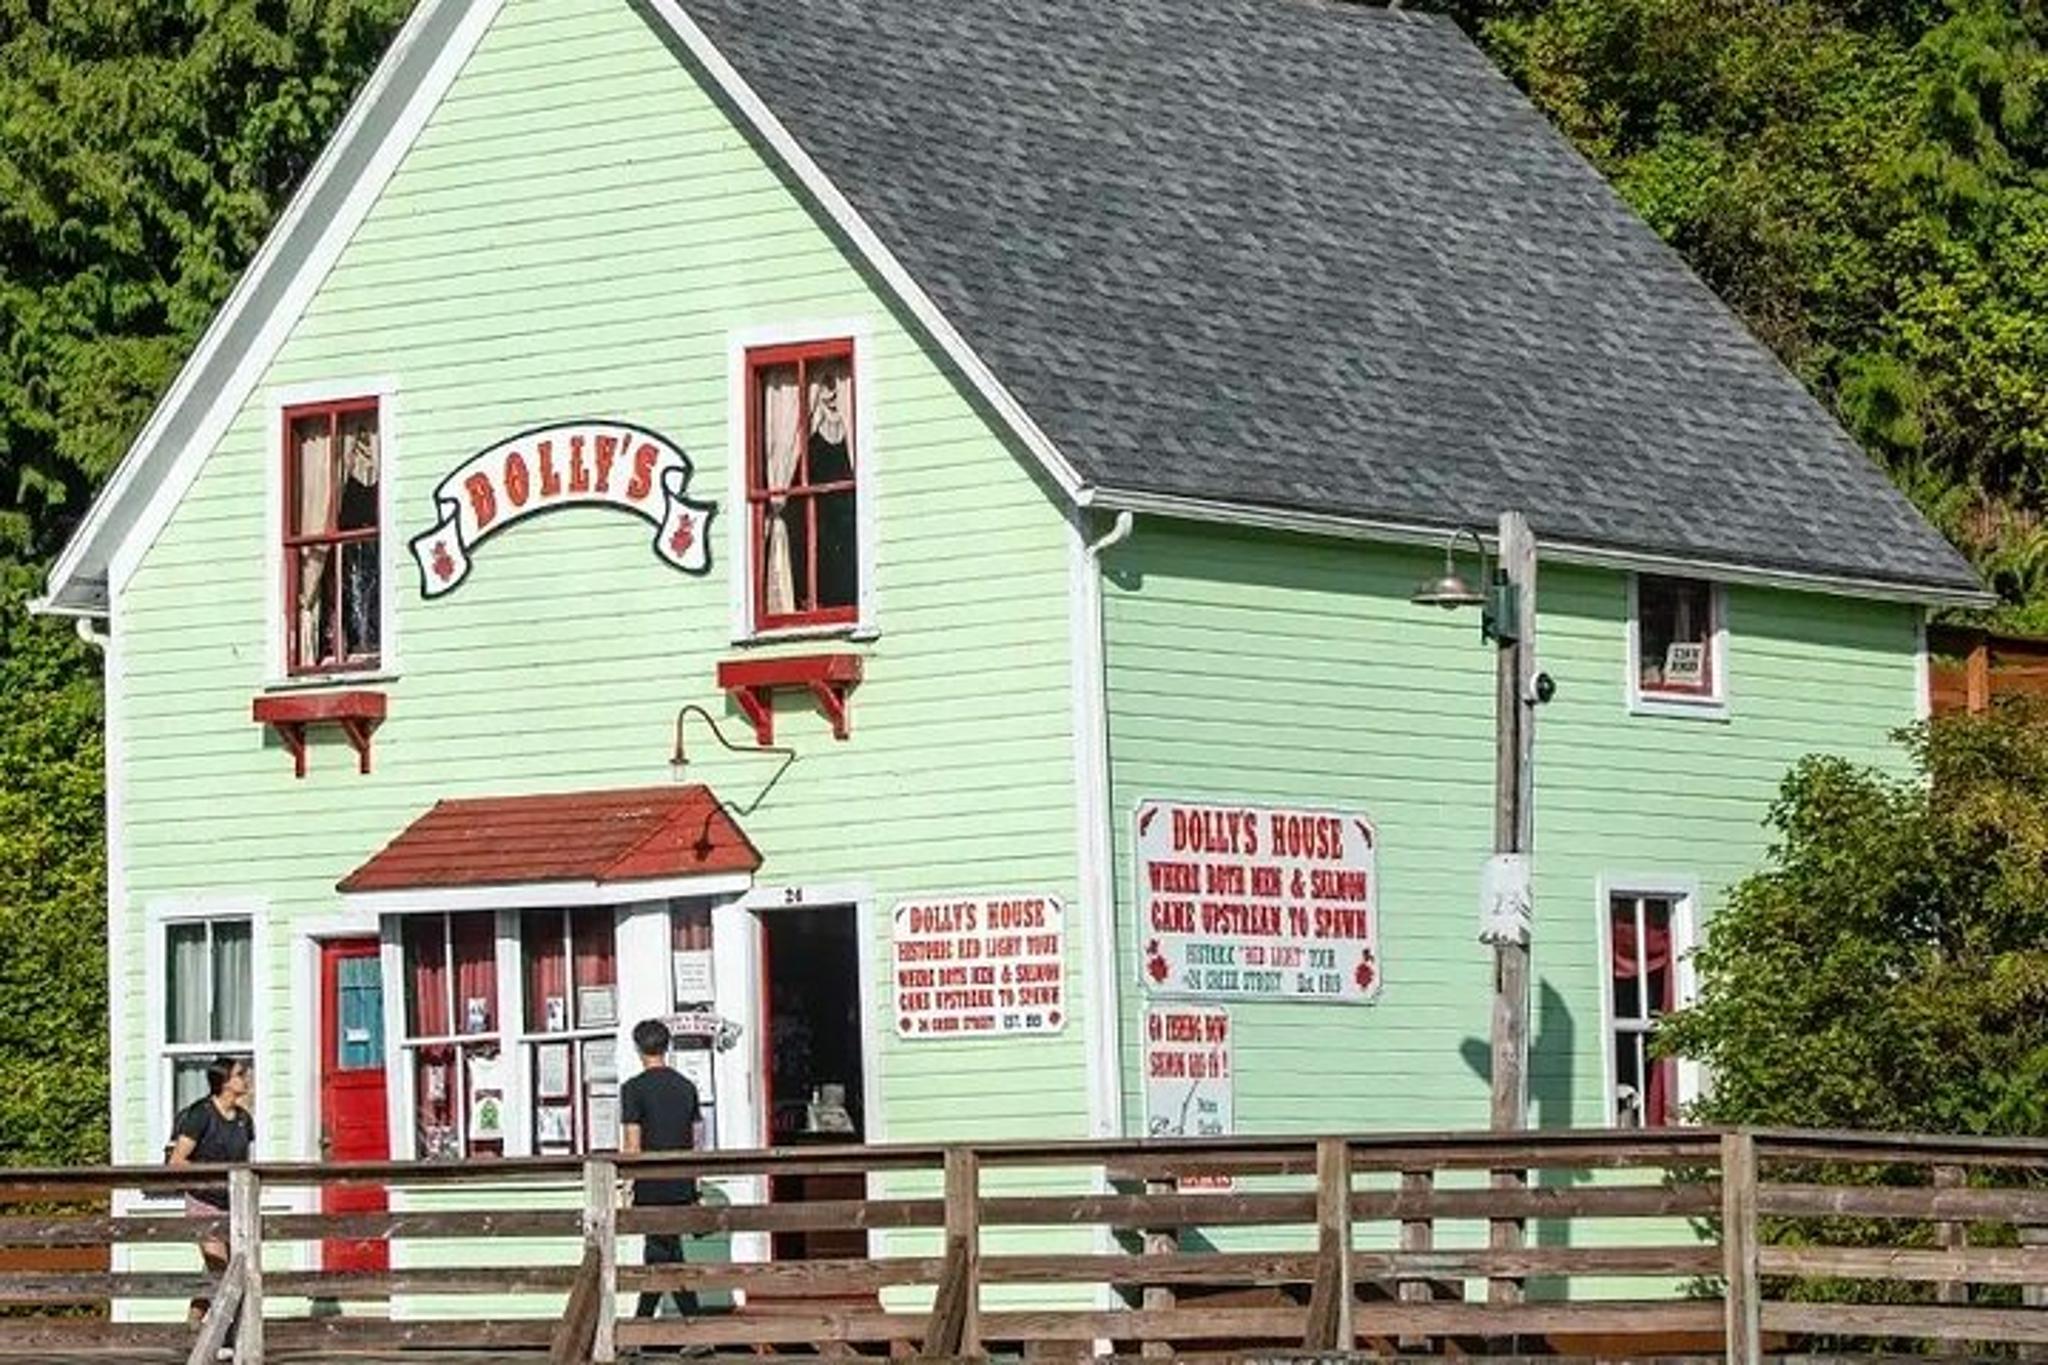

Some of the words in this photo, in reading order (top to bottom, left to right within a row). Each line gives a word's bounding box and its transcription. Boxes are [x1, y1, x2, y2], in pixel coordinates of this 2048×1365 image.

[464, 433, 660, 530] DOLLY'S
[1173, 808, 1259, 856] DOLLY'S
[1270, 814, 1343, 860] HOUSE
[1149, 861, 1201, 894] WHERE
[1206, 863, 1245, 896] BOTH
[1251, 866, 1282, 897] MEN
[1290, 868, 1306, 898] &
[1311, 869, 1367, 901] SALMON
[910, 903, 977, 934] DOLLY'S
[987, 899, 1045, 930] HOUSE
[1151, 901, 1196, 933] CAME
[1201, 903, 1282, 937] UPSTREAM
[1289, 906, 1309, 939] TO
[1314, 907, 1367, 939] SPAWN
[958, 938, 980, 960] RED
[987, 936, 1022, 957] LIGHT
[1027, 935, 1059, 955] TOUR
[1001, 964, 1013, 984] &
[999, 988, 1015, 1007] TO
